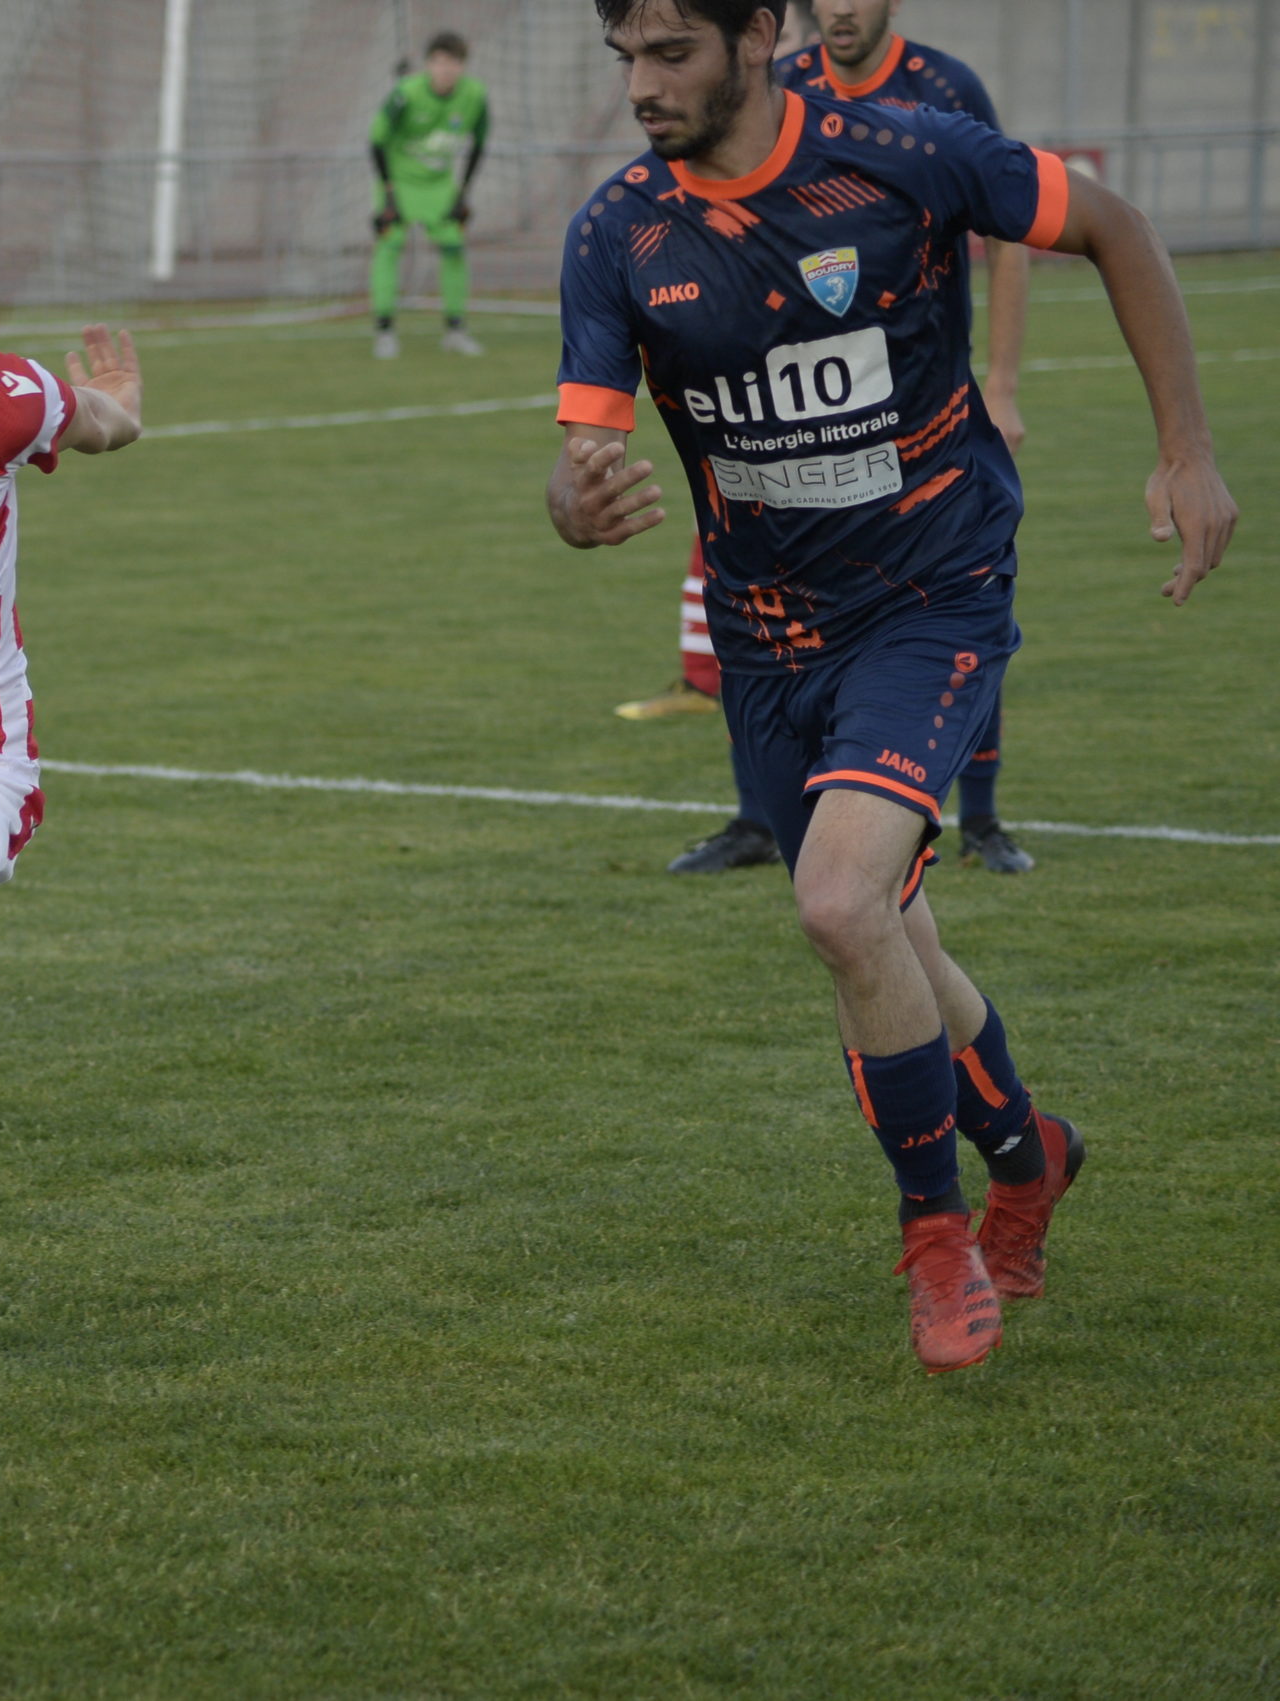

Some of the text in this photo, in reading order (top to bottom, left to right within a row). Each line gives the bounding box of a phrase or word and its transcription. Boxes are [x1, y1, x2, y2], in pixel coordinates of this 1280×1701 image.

[807, 262, 854, 280] BOUDRY
[648, 282, 700, 307] JAKO
[684, 355, 853, 424] eli10
[820, 411, 899, 443] littorale
[714, 449, 895, 490] SINGER
[840, 489, 875, 503] DEPUIS
[876, 749, 927, 783] JAKO
[900, 1113, 956, 1149] JAKO
